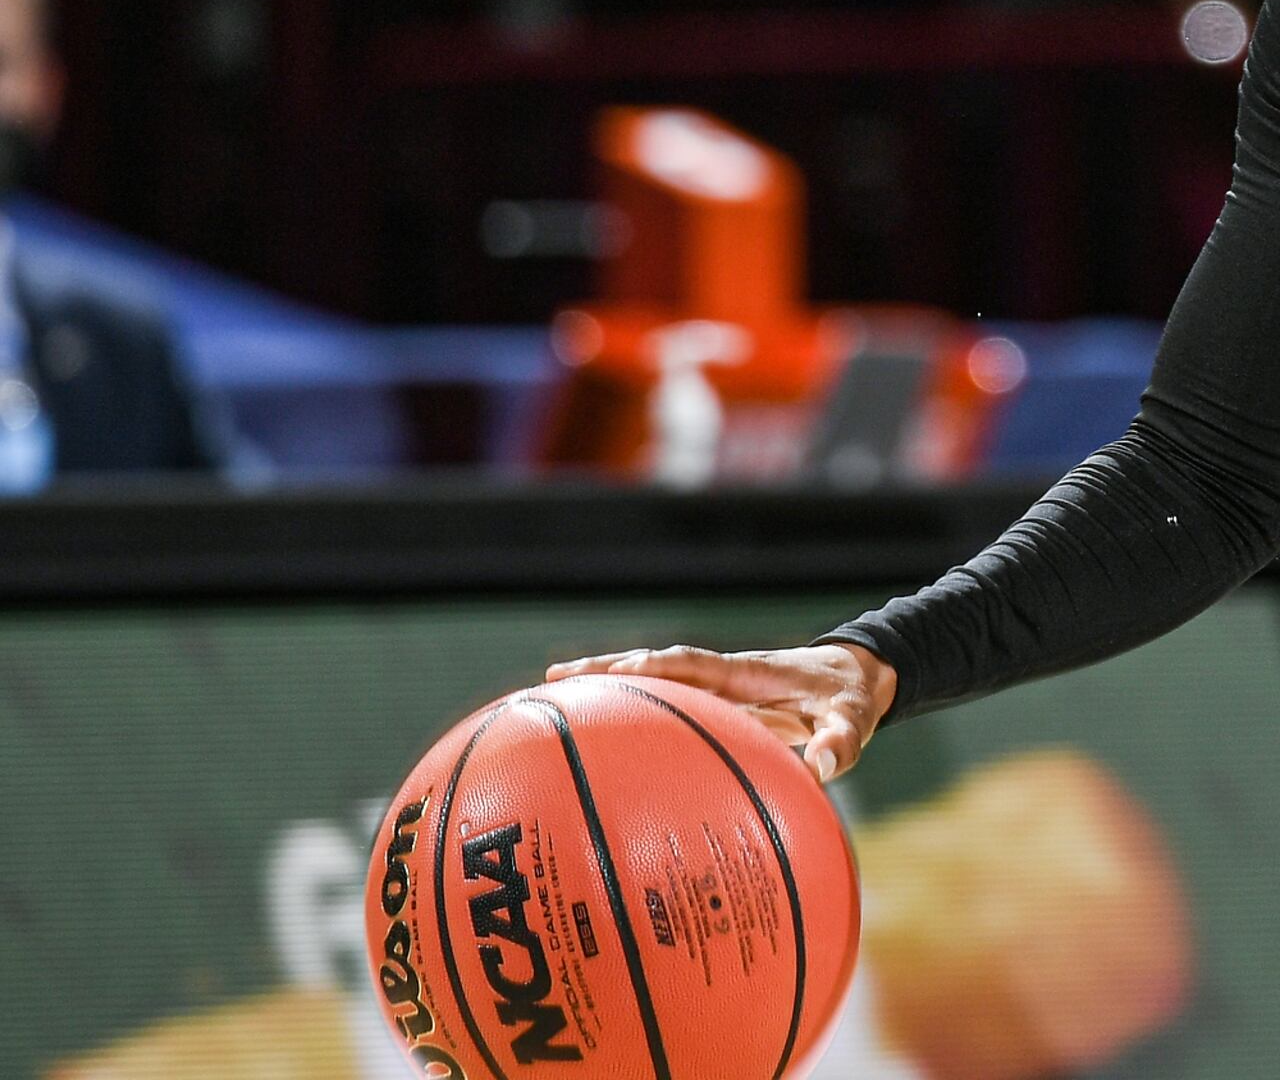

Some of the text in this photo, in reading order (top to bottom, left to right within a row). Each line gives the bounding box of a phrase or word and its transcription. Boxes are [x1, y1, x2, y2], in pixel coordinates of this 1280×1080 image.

[379, 795, 470, 1080] ilson
[410, 869, 418, 911] BALL
[461, 822, 584, 1065] NCAA
[529, 817, 597, 1049] OFFICIAL GAME BALL
